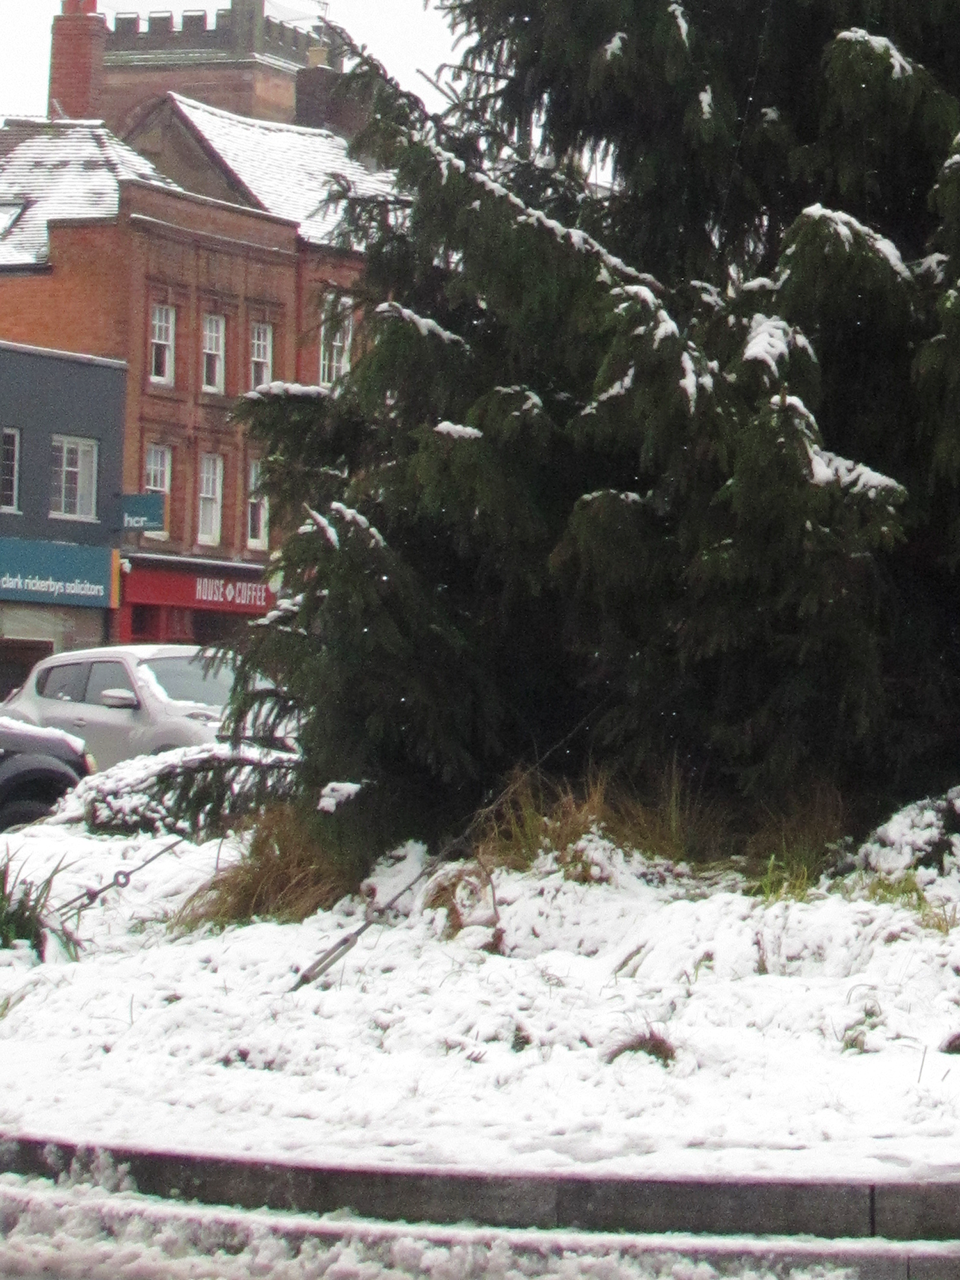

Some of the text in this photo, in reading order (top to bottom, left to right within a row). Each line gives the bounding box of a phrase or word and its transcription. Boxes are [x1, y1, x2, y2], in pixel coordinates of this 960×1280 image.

[124, 513, 147, 527] hcr
[1, 573, 104, 597] clark rickerbys solicitors
[196, 578, 224, 602] HOUSE
[235, 582, 267, 606] COFFEE
